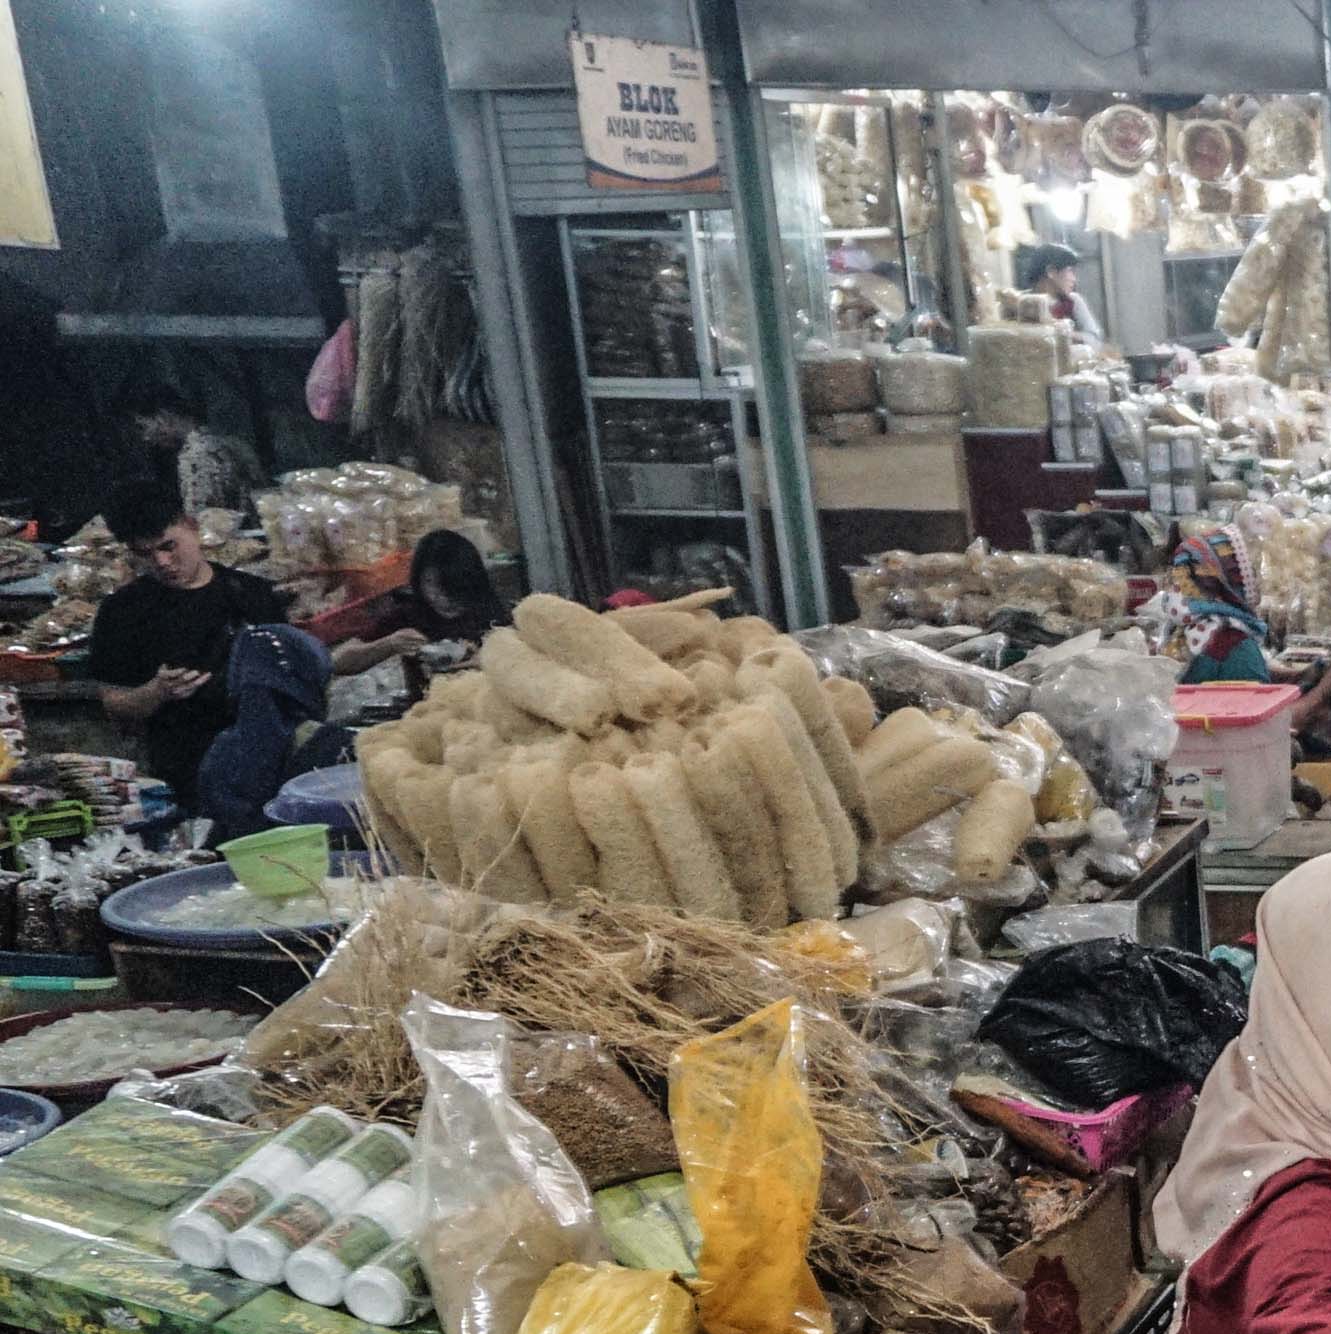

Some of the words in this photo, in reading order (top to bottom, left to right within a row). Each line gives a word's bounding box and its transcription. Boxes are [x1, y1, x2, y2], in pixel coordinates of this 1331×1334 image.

[618, 82, 679, 115] BLOK
[607, 117, 641, 138] AYAM
[645, 120, 696, 143] GORENG
